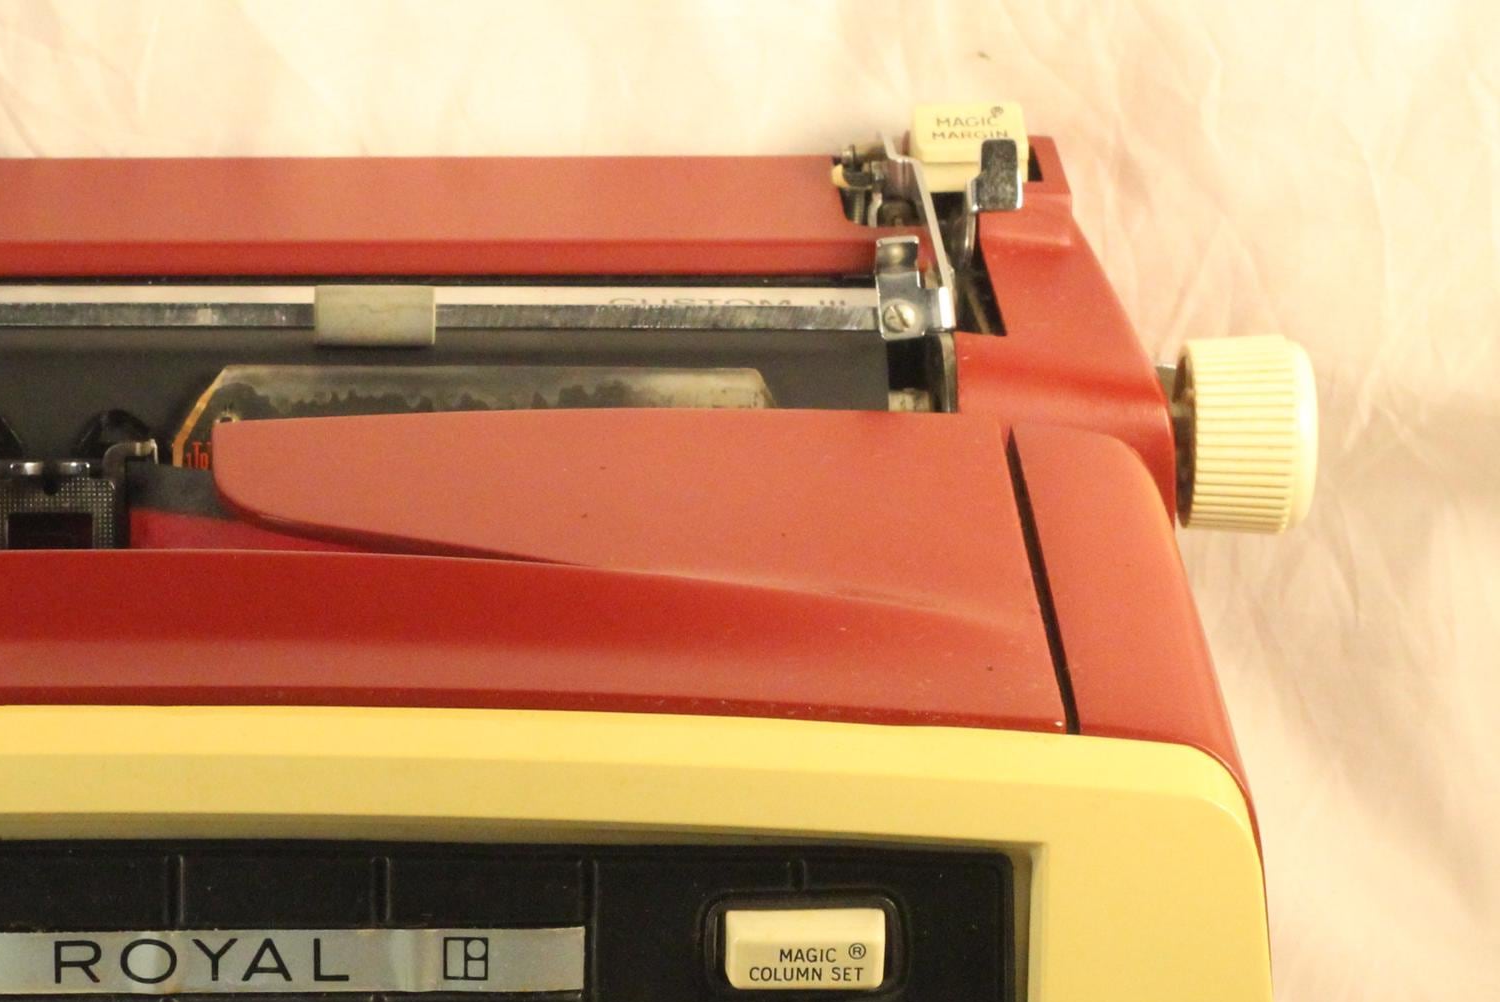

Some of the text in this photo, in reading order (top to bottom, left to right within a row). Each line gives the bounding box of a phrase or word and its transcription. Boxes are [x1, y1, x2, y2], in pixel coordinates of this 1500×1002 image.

[53, 937, 350, 985] ROYAL
[779, 947, 837, 964] MAGIC
[749, 966, 864, 982] COLUMN SET
